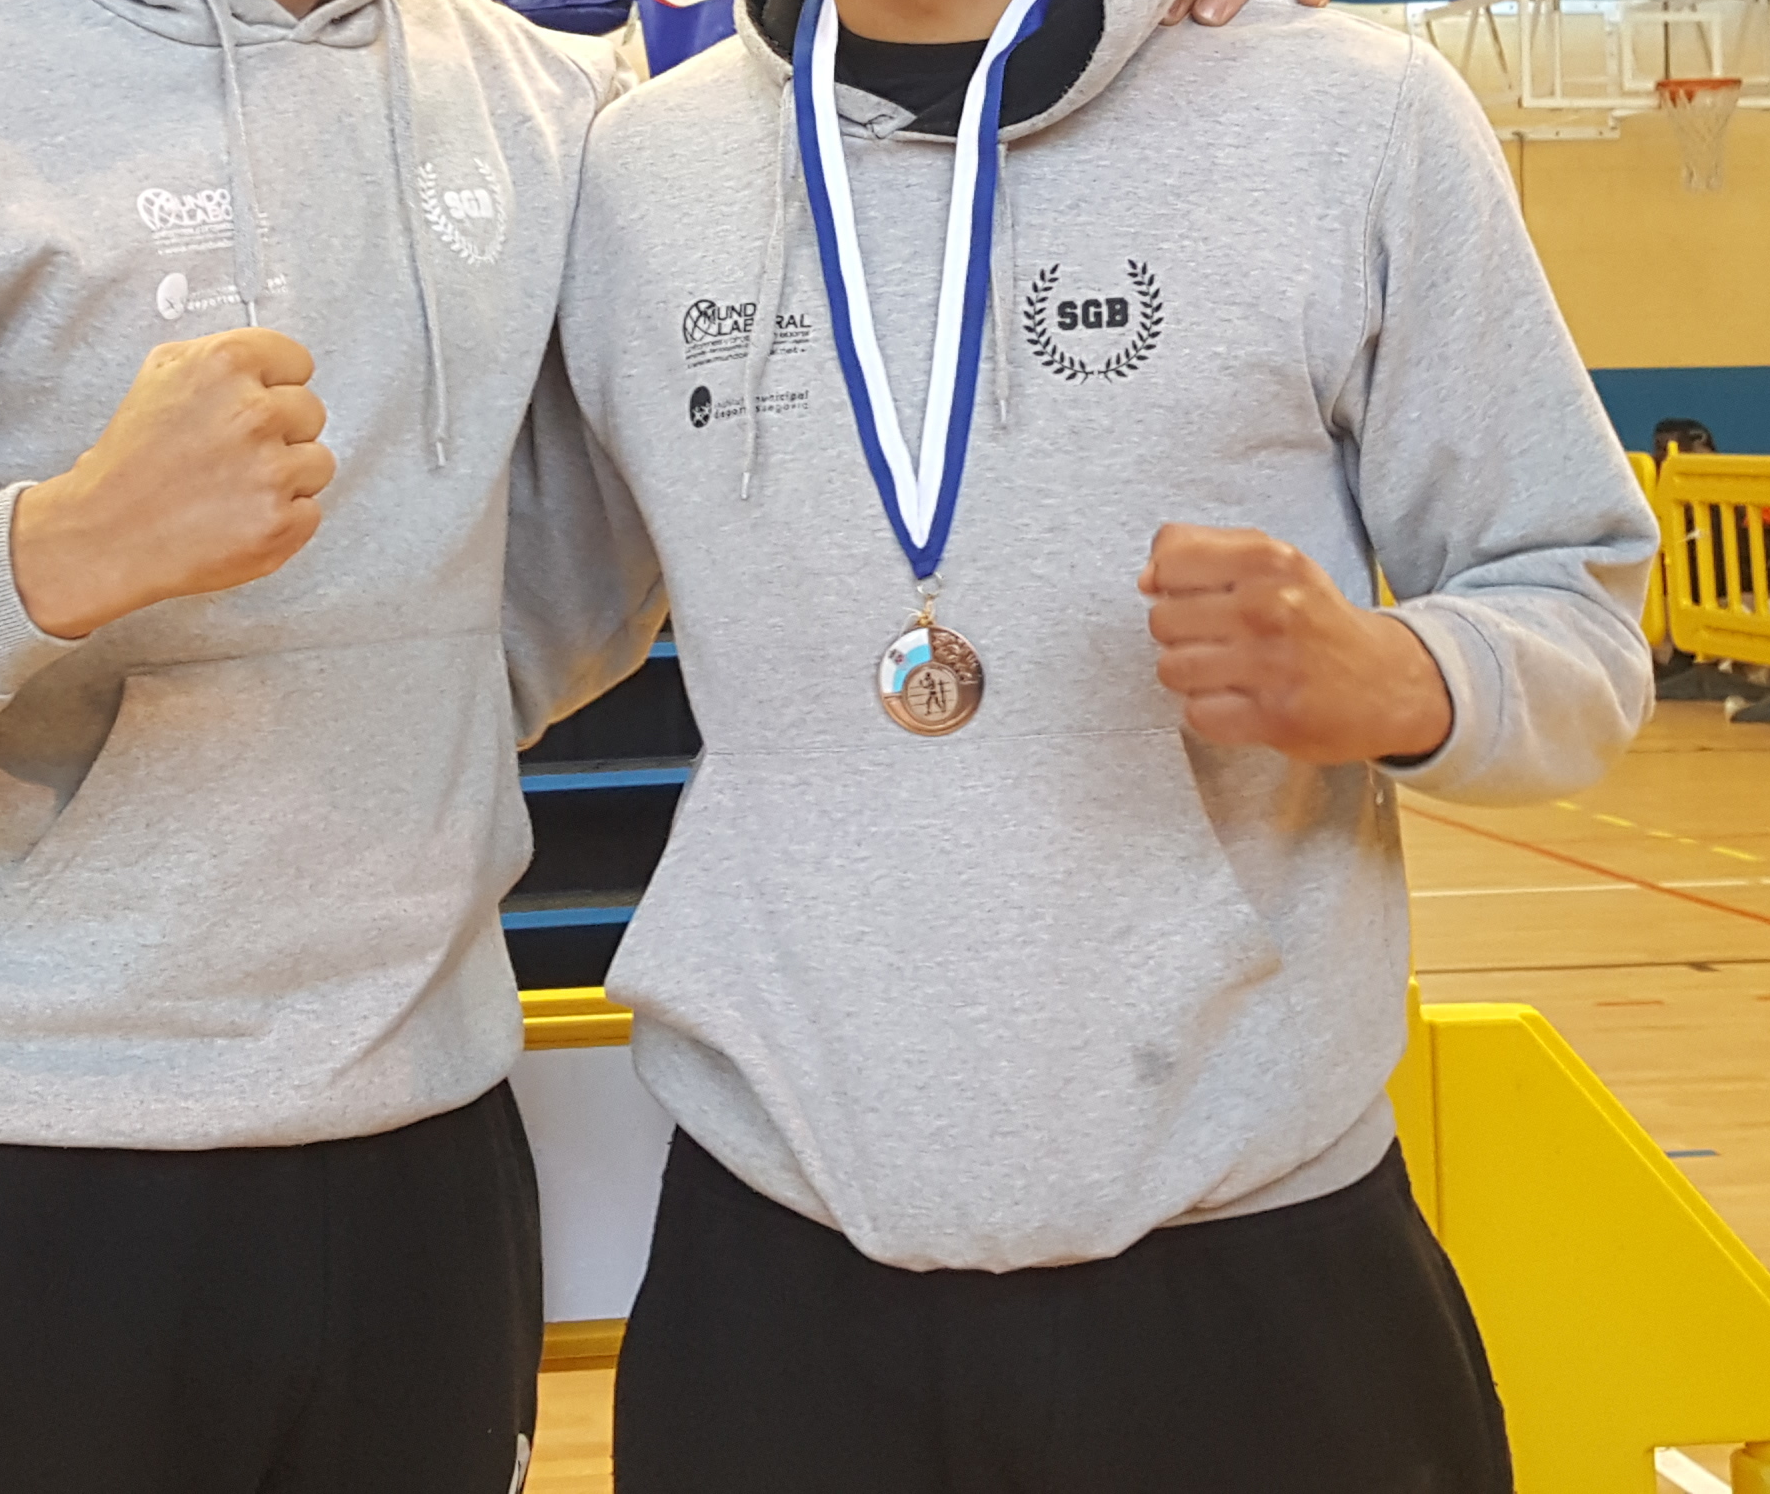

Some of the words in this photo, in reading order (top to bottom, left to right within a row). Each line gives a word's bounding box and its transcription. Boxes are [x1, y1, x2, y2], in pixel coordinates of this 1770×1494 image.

[703, 302, 757, 325] MUND
[718, 313, 813, 336] LABRAL
[1057, 297, 1129, 331] SGB
